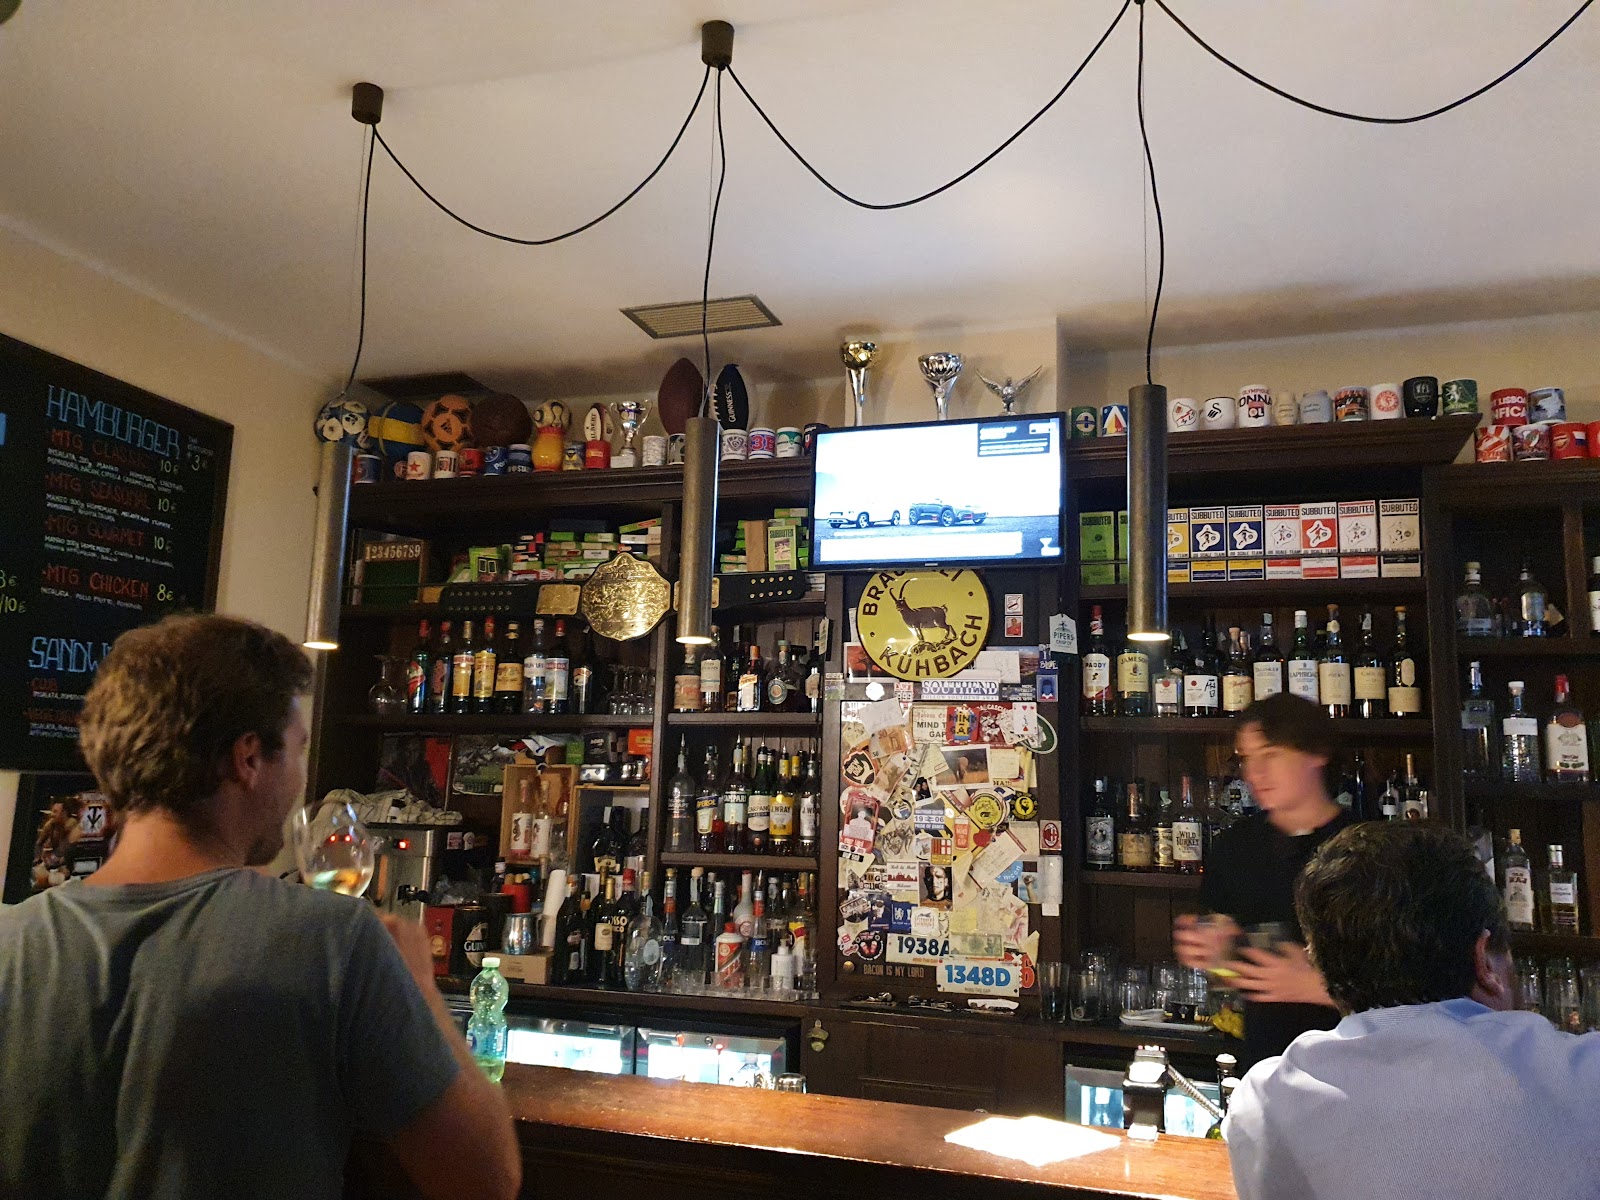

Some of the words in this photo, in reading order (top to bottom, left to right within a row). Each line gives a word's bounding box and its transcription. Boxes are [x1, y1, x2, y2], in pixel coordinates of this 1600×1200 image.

[725, 391, 737, 422] GUINNESS
[45, 384, 181, 460] HAMBURGER
[1301, 507, 1336, 516] SUBBUTEO
[1339, 504, 1375, 515] SUBBUTEO
[1381, 503, 1418, 513] SUBBUTEO
[1190, 510, 1224, 520] SUBBUTEO
[1228, 509, 1261, 518] SUBBUTEO
[1266, 509, 1300, 518] SUBBUTEO
[770, 529, 793, 538] SUBBUTEO
[365, 544, 421, 560] 123456789
[47, 563, 79, 586] MTG
[90, 571, 150, 600] CHICKEN
[1053, 631, 1075, 641] PIPERS
[879, 614, 983, 677] KÜHBACH
[922, 679, 998, 695] SOUTHEND
[916, 721, 940, 729] MIND
[1179, 830, 1196, 840] WILD
[1175, 836, 1200, 847] TURKEY
[662, 934, 676, 942] OLS
[863, 964, 884, 976] BACON
[886, 965, 893, 976] IS
[907, 967, 925, 978] LORD
[945, 964, 1011, 987] 1348D
